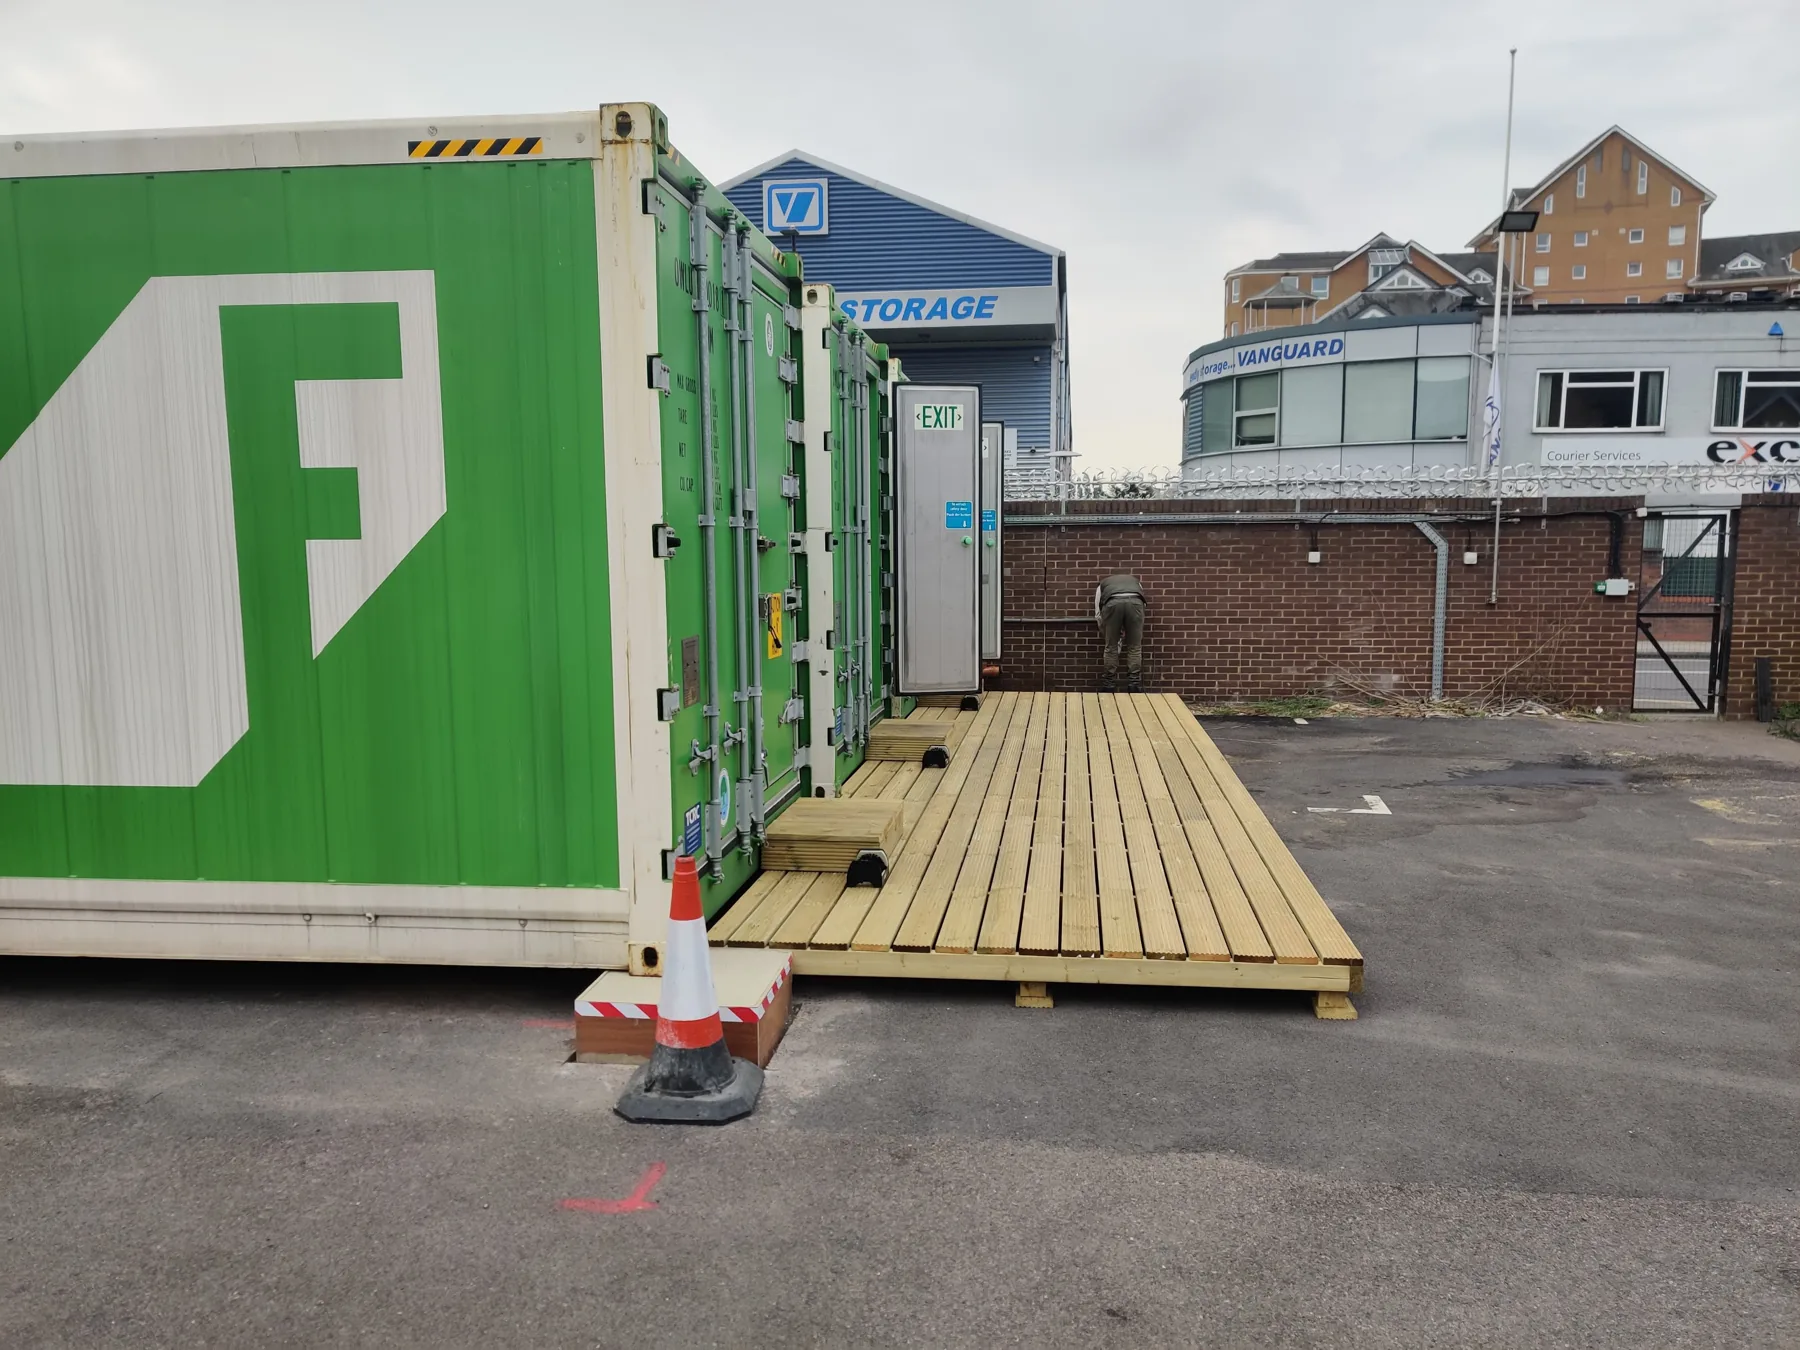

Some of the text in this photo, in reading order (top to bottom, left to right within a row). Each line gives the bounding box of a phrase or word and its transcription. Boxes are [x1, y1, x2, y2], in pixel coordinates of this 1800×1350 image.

[840, 295, 999, 322] STORAGE
[1237, 338, 1344, 367] VANGUARD
[922, 405, 958, 429] EXIT
[1547, 449, 1641, 461] Courier Services
